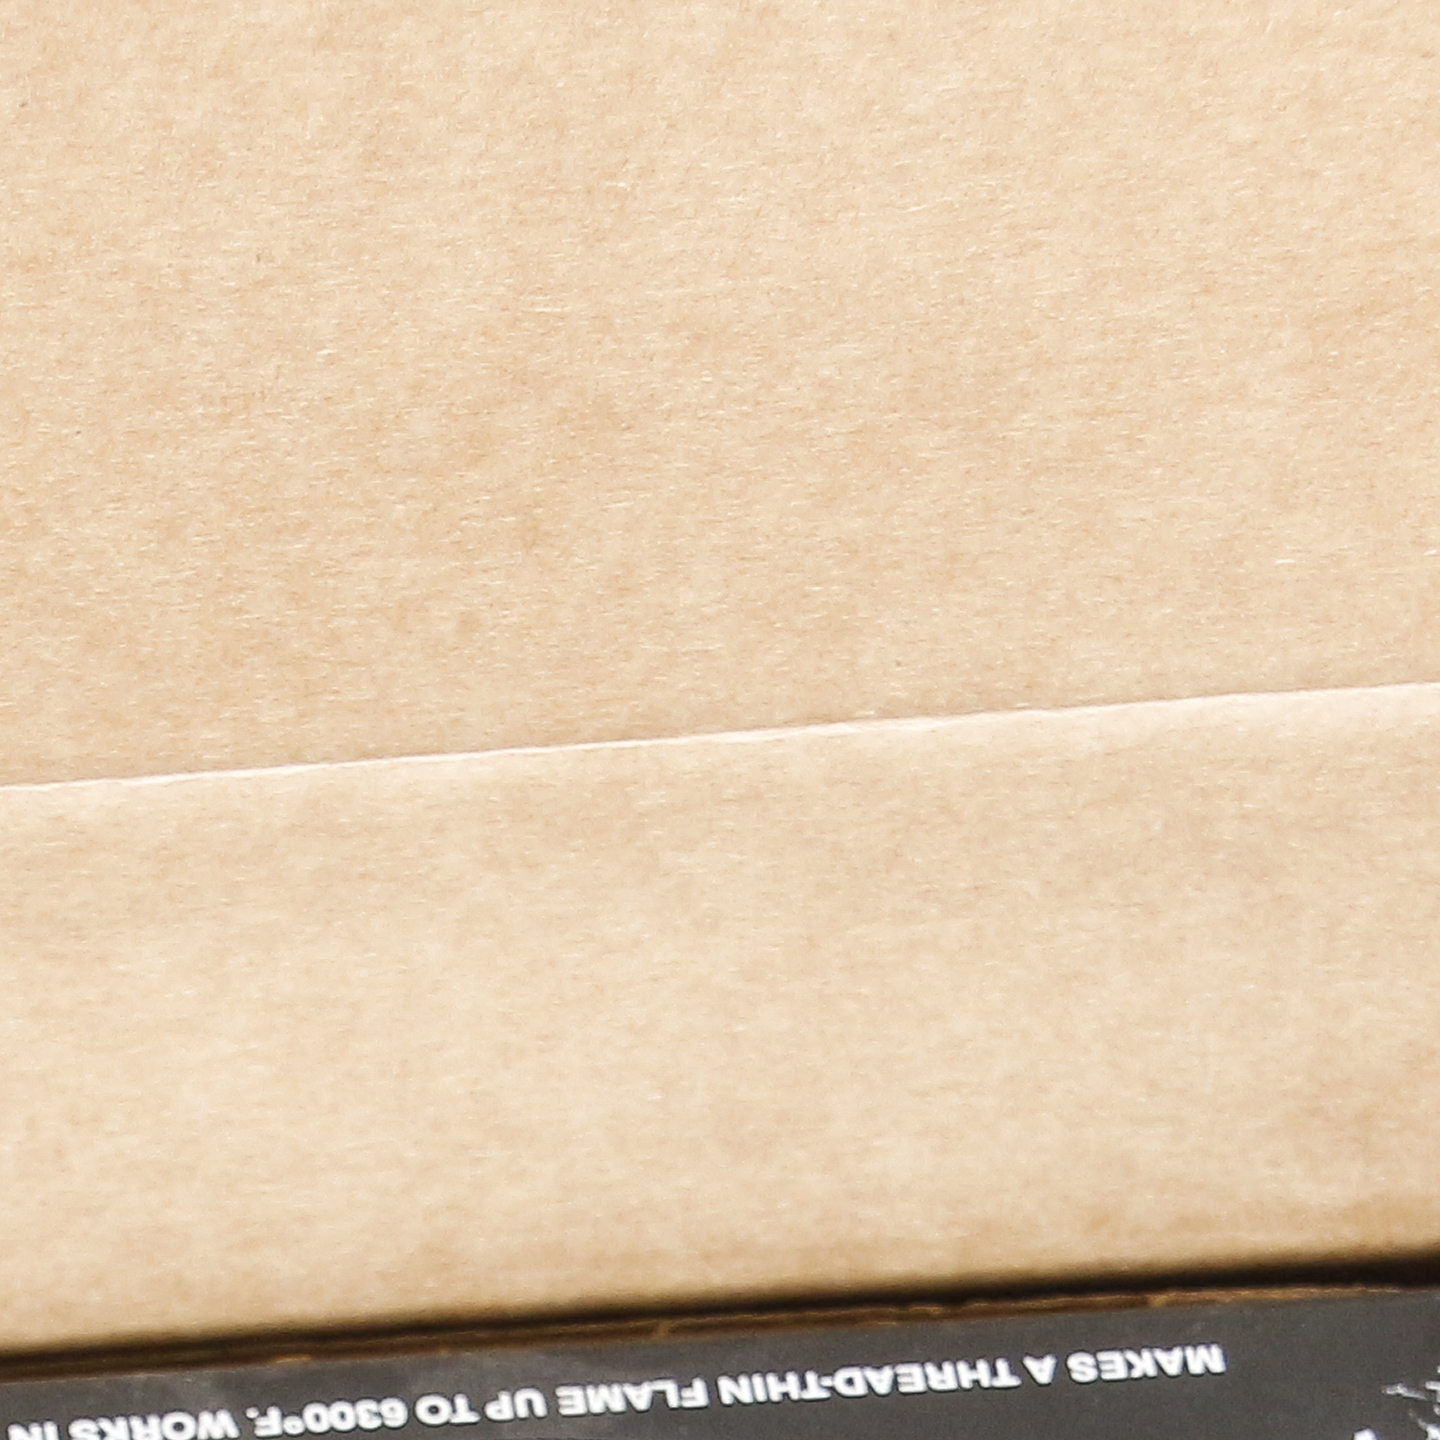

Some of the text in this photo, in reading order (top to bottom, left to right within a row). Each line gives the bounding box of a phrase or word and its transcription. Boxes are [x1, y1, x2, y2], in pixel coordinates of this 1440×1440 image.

[715, 1353, 1017, 1409] THREAD-THIN
[1021, 1350, 1056, 1388] A
[1066, 1338, 1225, 1384] MAKES
[413, 1391, 476, 1430] TO
[480, 1386, 547, 1425] UP
[554, 1374, 707, 1420] FLAME
